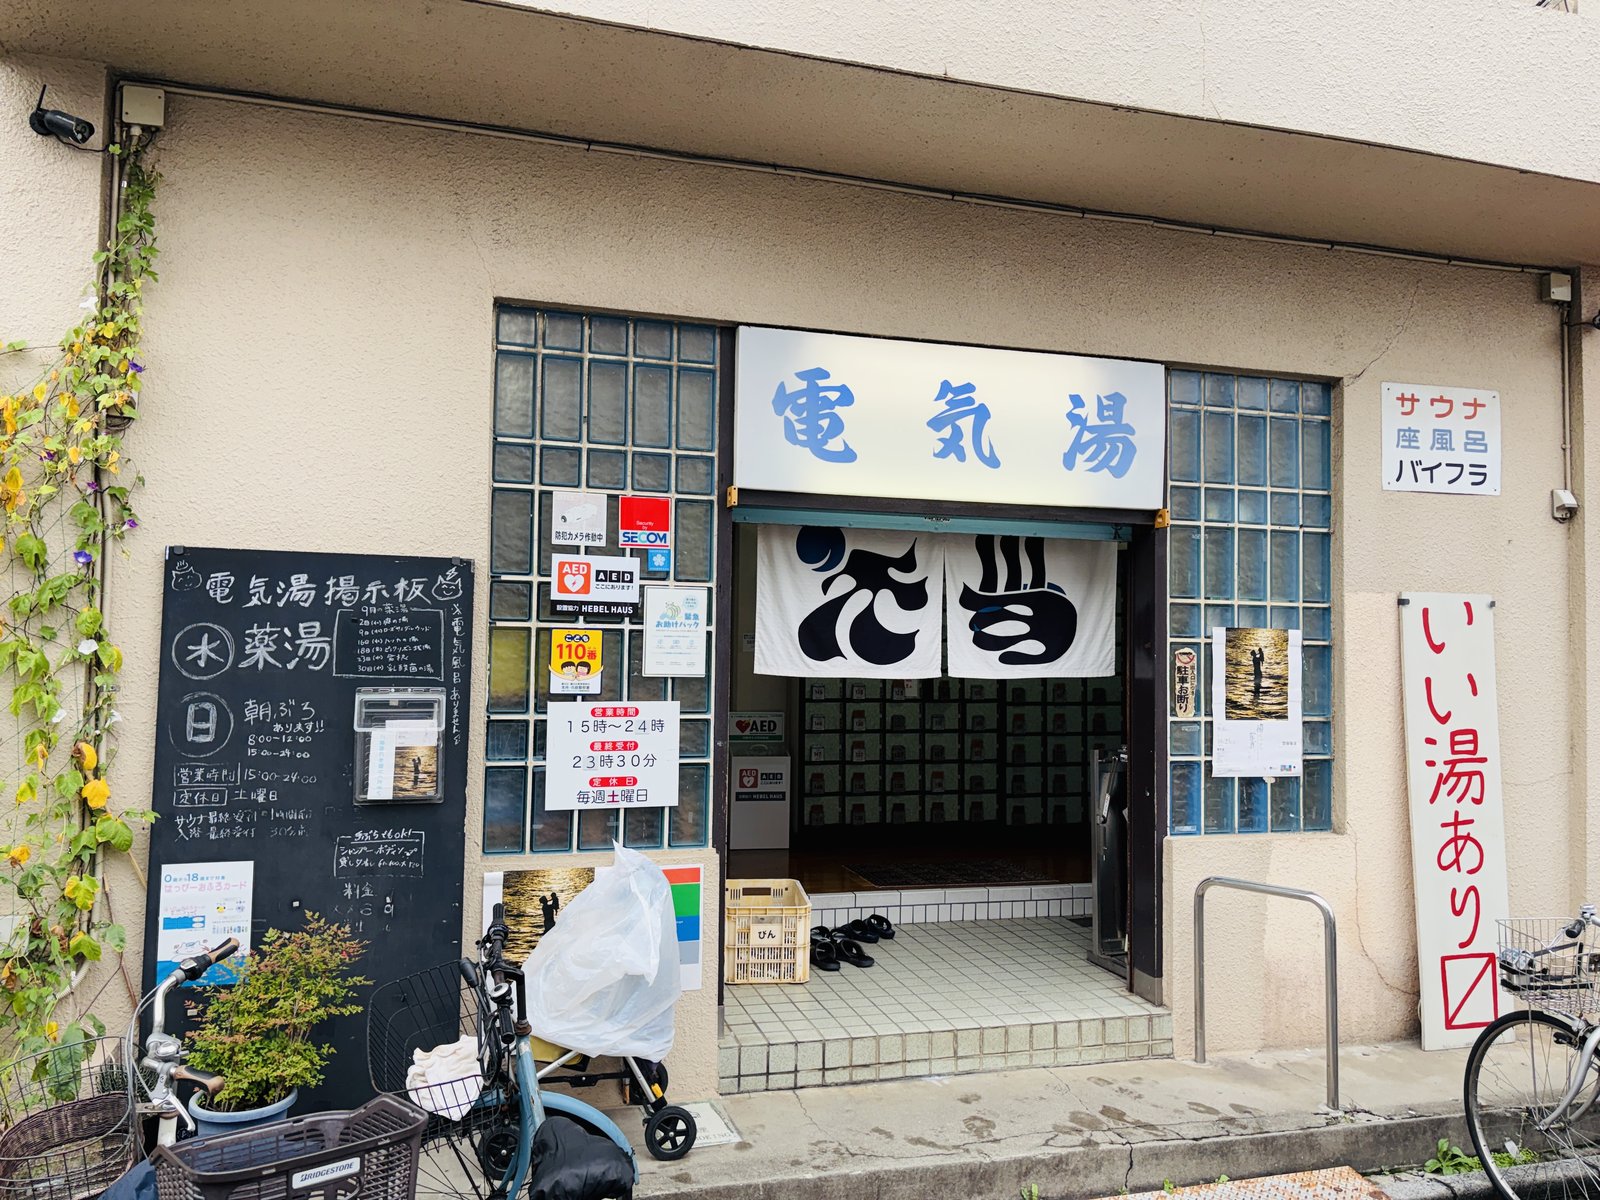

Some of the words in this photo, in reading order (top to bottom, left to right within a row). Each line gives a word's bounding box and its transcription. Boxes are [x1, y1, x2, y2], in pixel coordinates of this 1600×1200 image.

[1396, 393, 1486, 420] サウナ
[771, 366, 1137, 479] 電気湯
[1396, 427, 1488, 453] 座風呂
[555, 531, 603, 543] 防犯カメラ作動中
[622, 532, 667, 544] SECOM
[562, 563, 588, 574] AED
[206, 572, 432, 608] 電気湯掲示板
[582, 605, 609, 613] HEBEL
[565, 634, 589, 642] こども
[237, 621, 333, 671] 薬湯
[556, 643, 597, 660] 110番
[1176, 665, 1190, 713] 駐車お断り
[243, 699, 316, 723] 朝ぶろ
[594, 707, 636, 717] 営業時間
[749, 719, 777, 732] AED
[593, 742, 635, 751] 最終受付
[572, 754, 657, 769] 23時30分
[177, 768, 235, 784] 営業時間
[741, 769, 756, 777] AED
[592, 777, 635, 787] 定休日
[179, 789, 220, 805] 定休日
[231, 788, 278, 803] 土曜日
[577, 789, 647, 804] 毎週土曜日
[343, 881, 375, 899] 料金
[757, 929, 776, 940] びん
[300, 1161, 355, 1183] BRIDGESTONE
